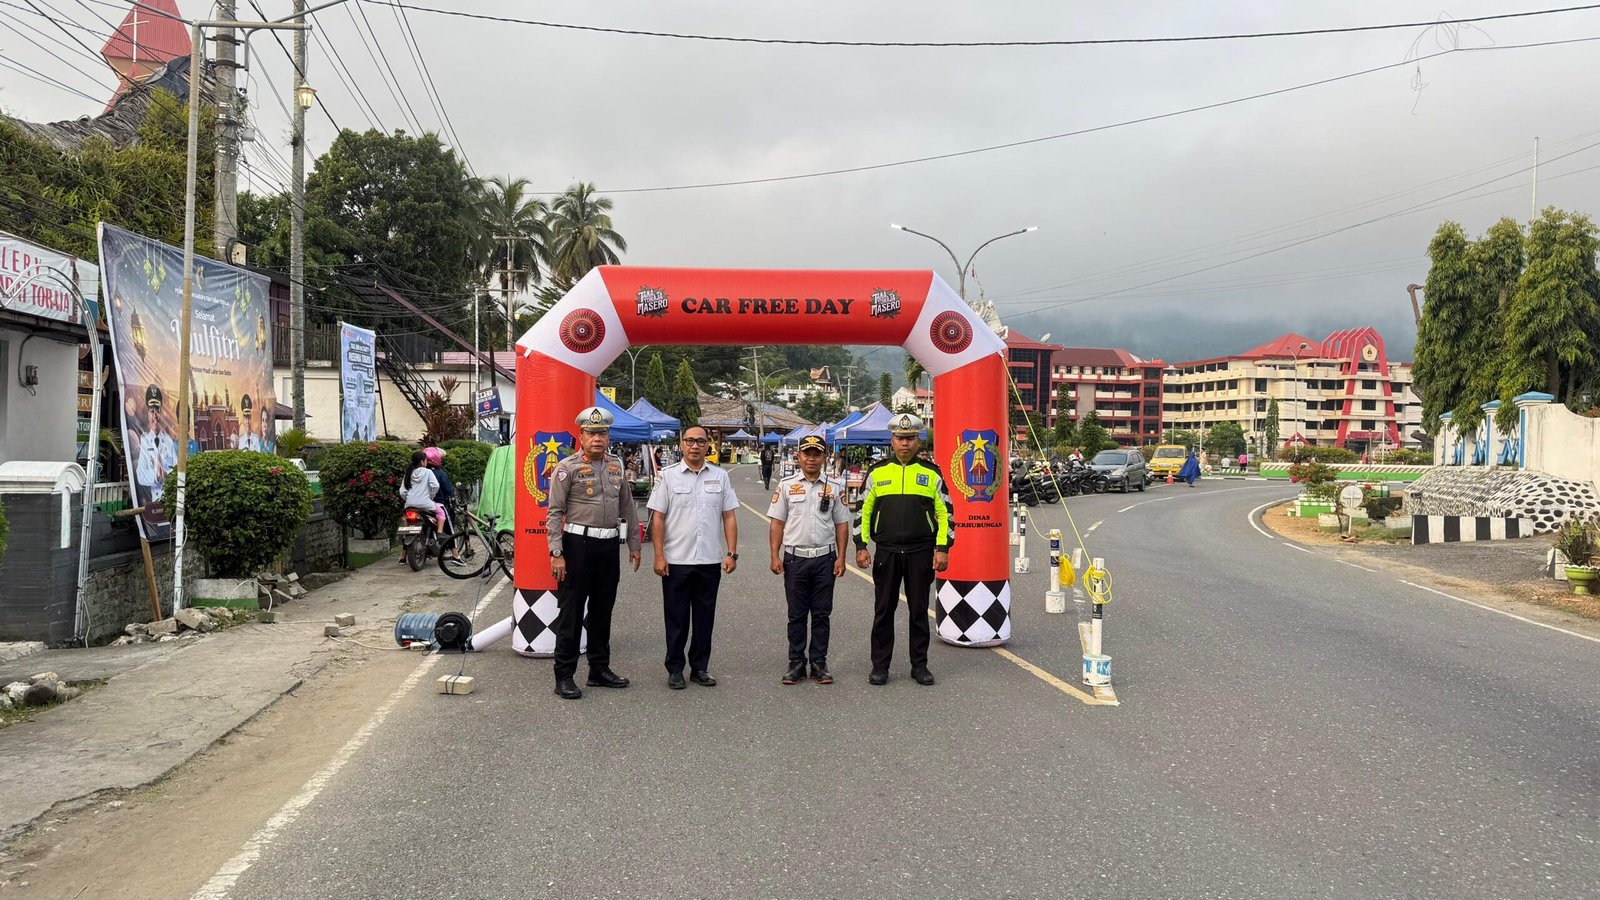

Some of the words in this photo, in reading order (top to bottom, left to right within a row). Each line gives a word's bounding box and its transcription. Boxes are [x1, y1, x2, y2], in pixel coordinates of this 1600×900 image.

[31, 283, 70, 314] TORAJA
[681, 297, 732, 314] CAR
[738, 298, 799, 315] FREE
[804, 298, 855, 315] DAY
[194, 309, 216, 323] Selamat
[637, 299, 668, 316] MASERO
[871, 300, 901, 317] MASERO
